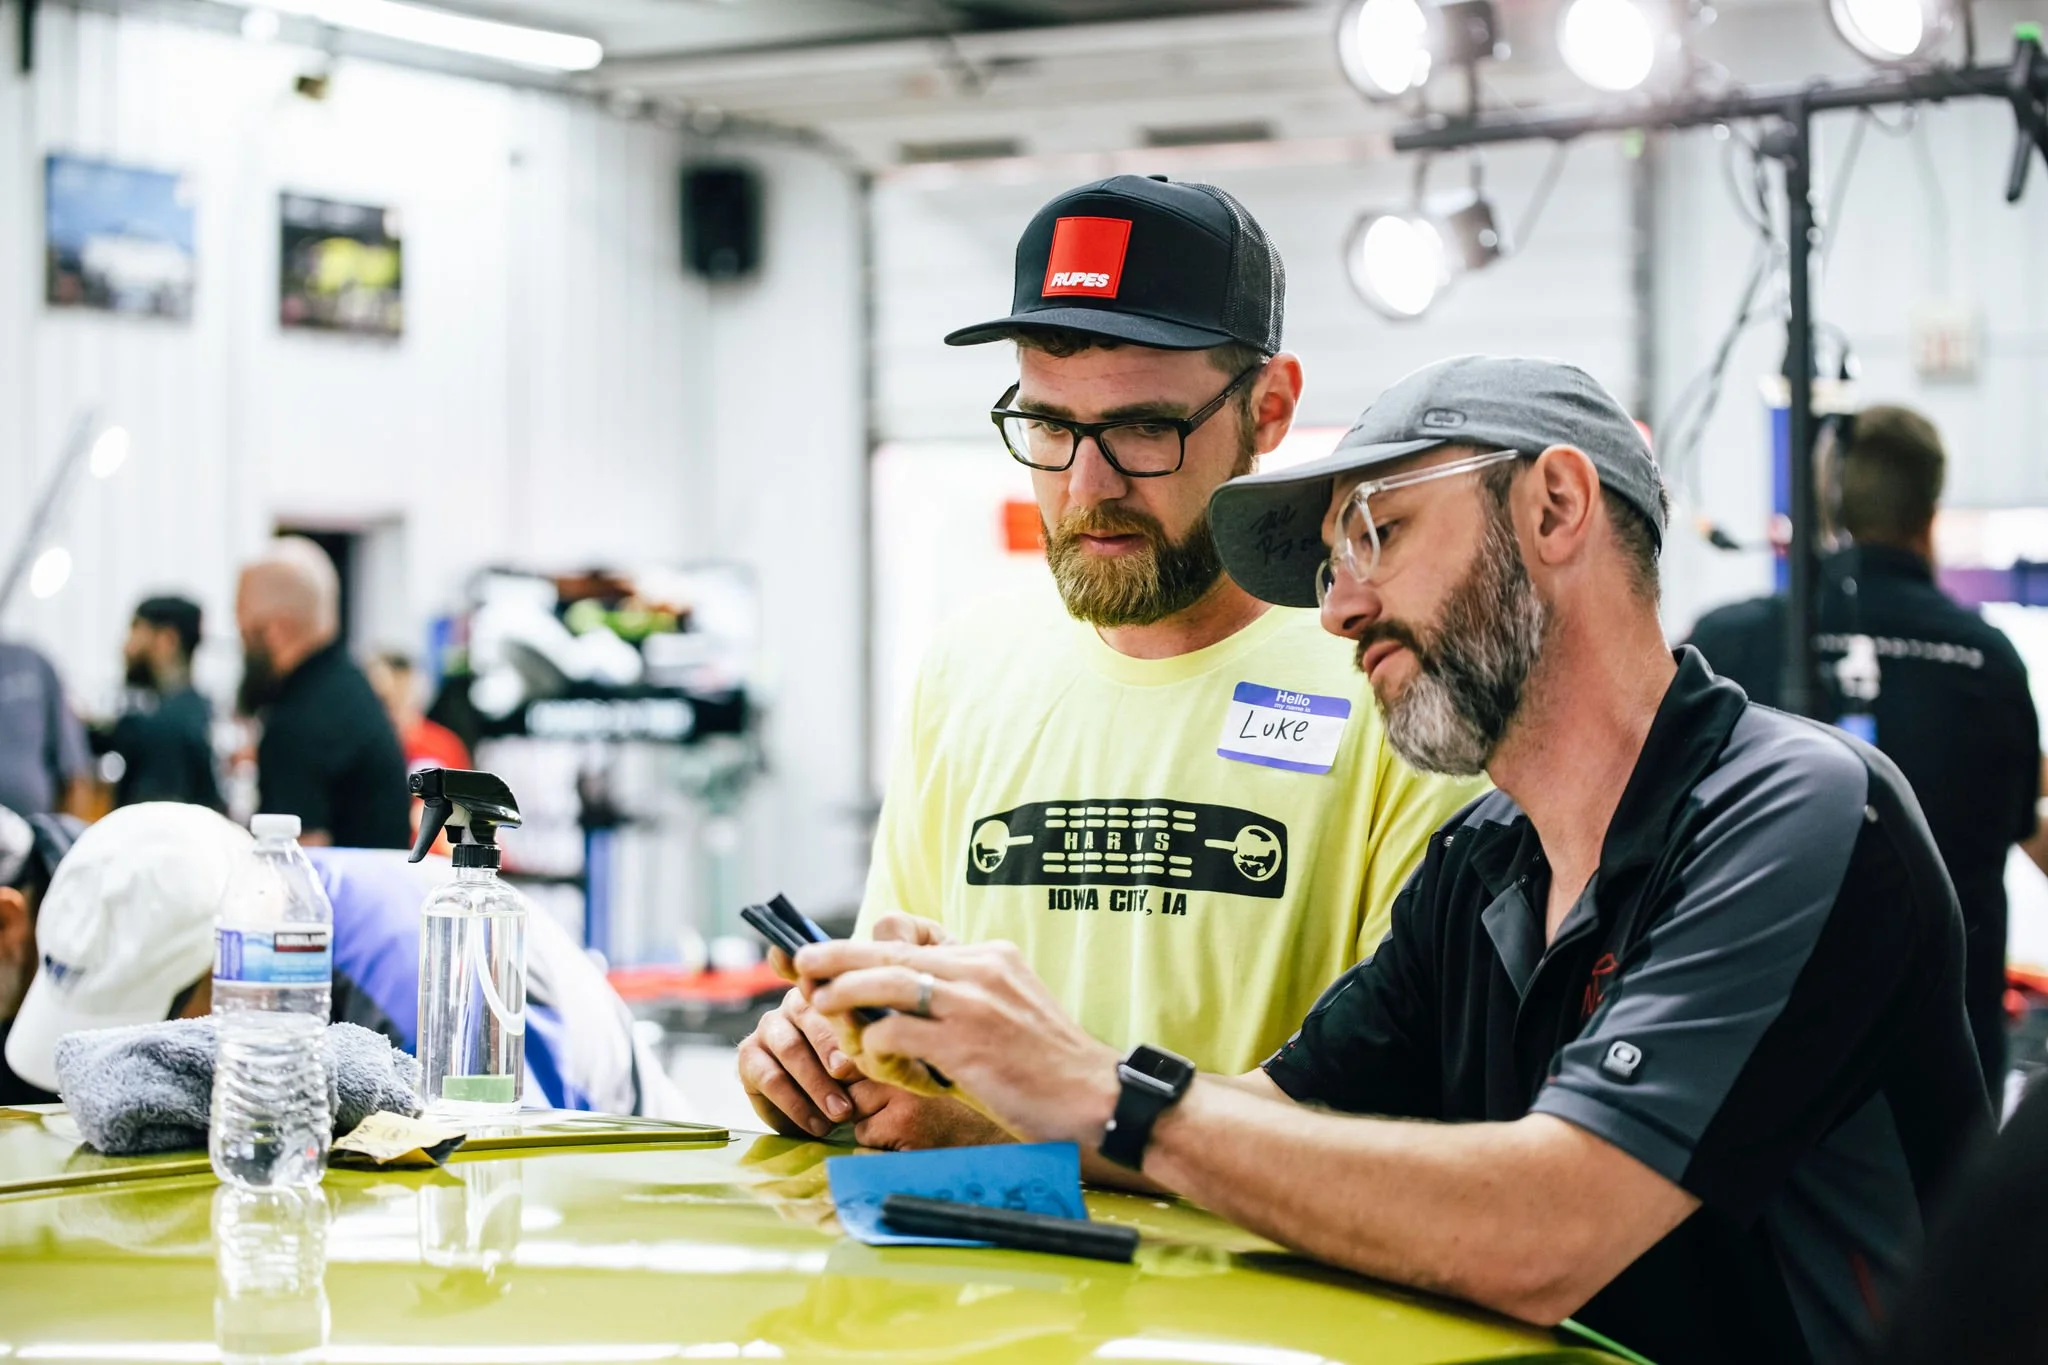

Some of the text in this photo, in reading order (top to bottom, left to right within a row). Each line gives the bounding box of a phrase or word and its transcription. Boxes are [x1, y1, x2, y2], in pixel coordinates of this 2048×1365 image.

[1051, 272, 1110, 288] RUPES
[1275, 690, 1311, 707] Hello
[1048, 888, 1187, 917] IOWA CITY, IA
